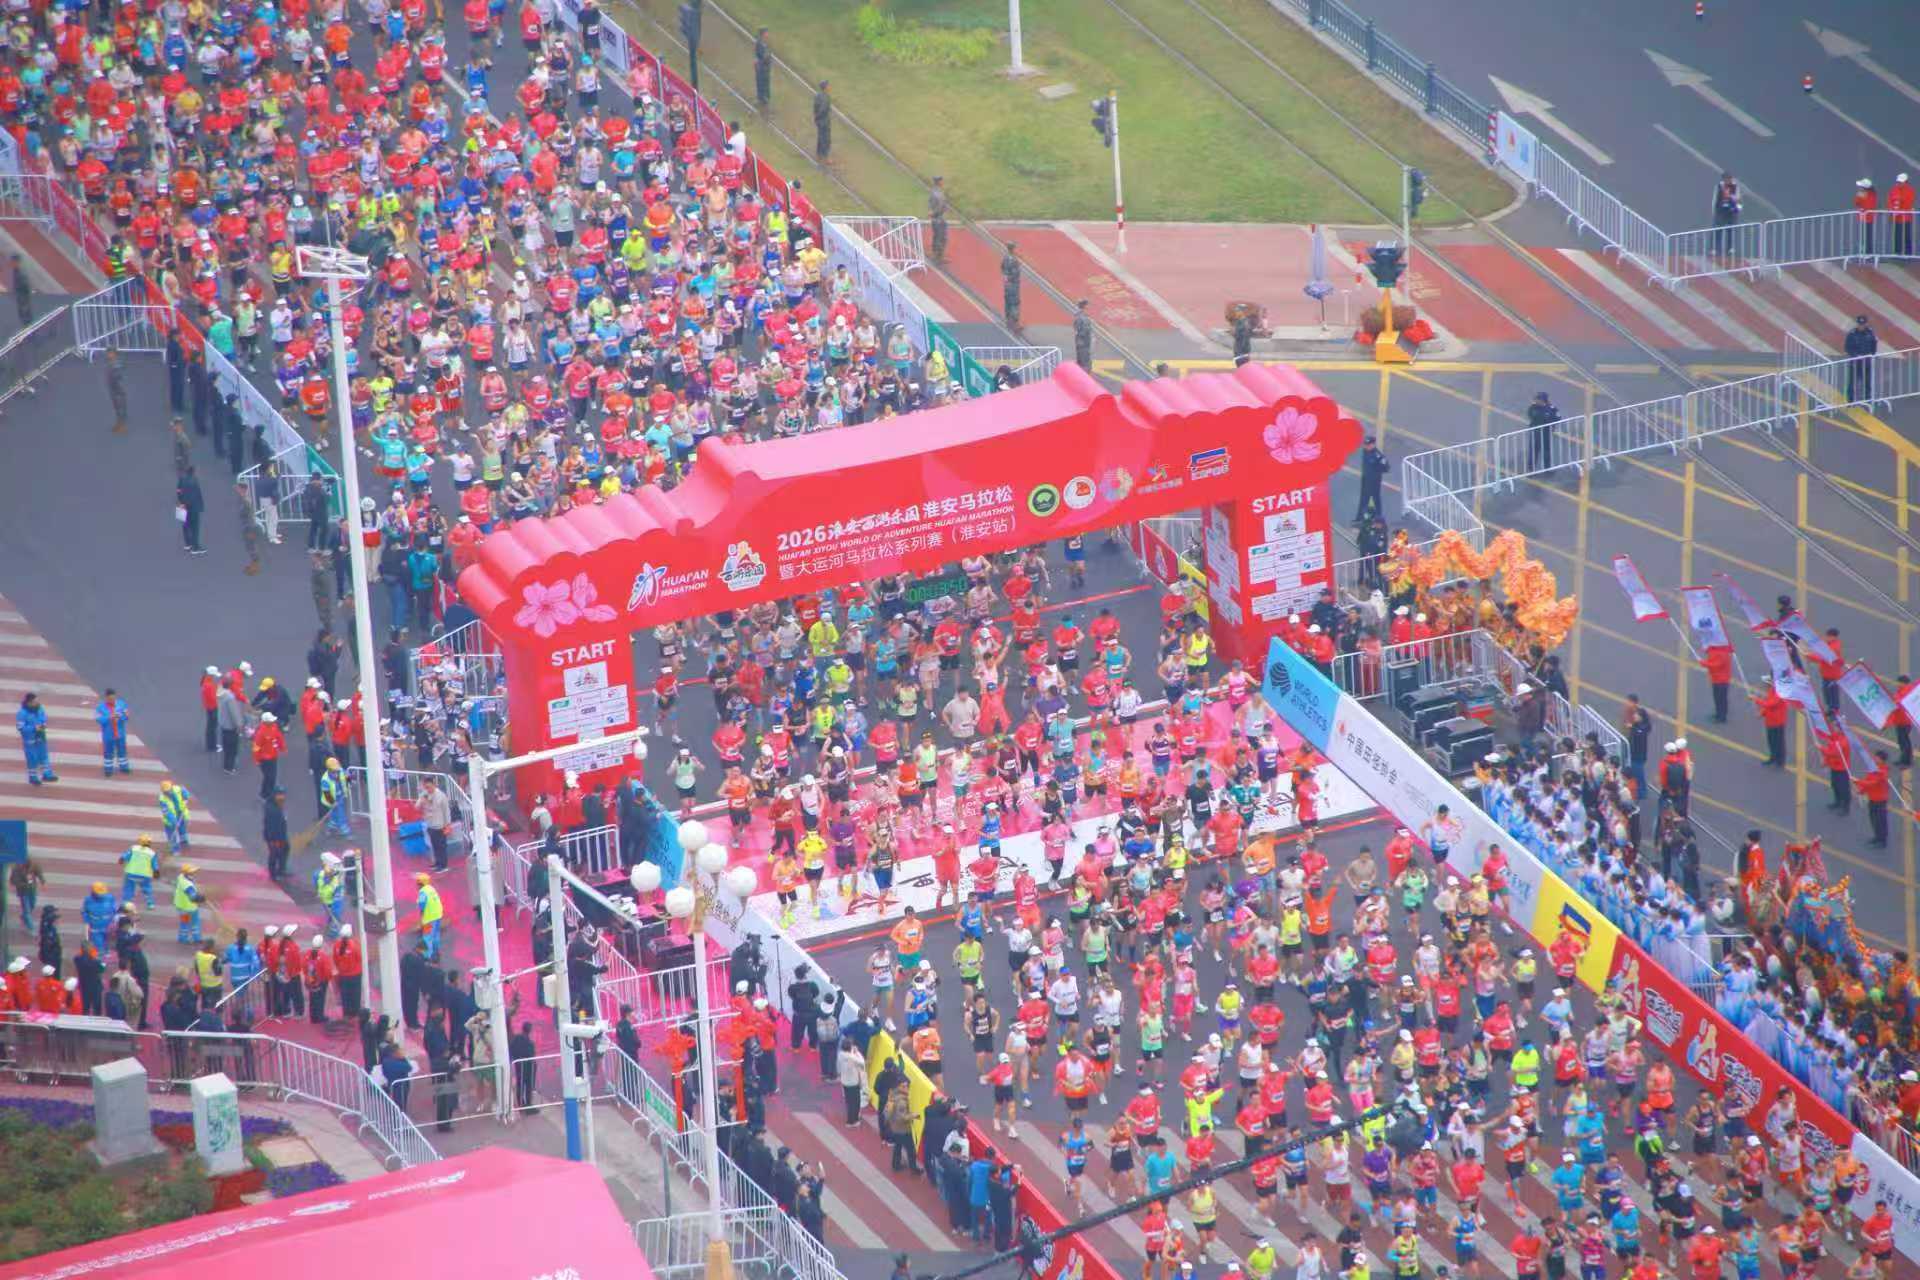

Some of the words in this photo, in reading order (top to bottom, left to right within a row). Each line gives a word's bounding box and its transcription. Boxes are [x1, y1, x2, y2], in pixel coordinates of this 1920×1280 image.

[922, 485, 1013, 518] 淮安马拉松
[1252, 487, 1314, 513] START
[840, 536, 869, 549] WORLD
[871, 533, 882, 543] OF
[885, 522, 934, 539] ADVENTURE
[969, 505, 1015, 521] MARATHON
[779, 515, 1017, 580] 暨大运河马拉松系列赛（淮安站）
[660, 582, 707, 598] MARATHON
[551, 639, 617, 667] START
[1293, 679, 1320, 707] WORLD
[1290, 695, 1329, 732] ATHLETICS
[1346, 733, 1400, 785] 中国田径协会
